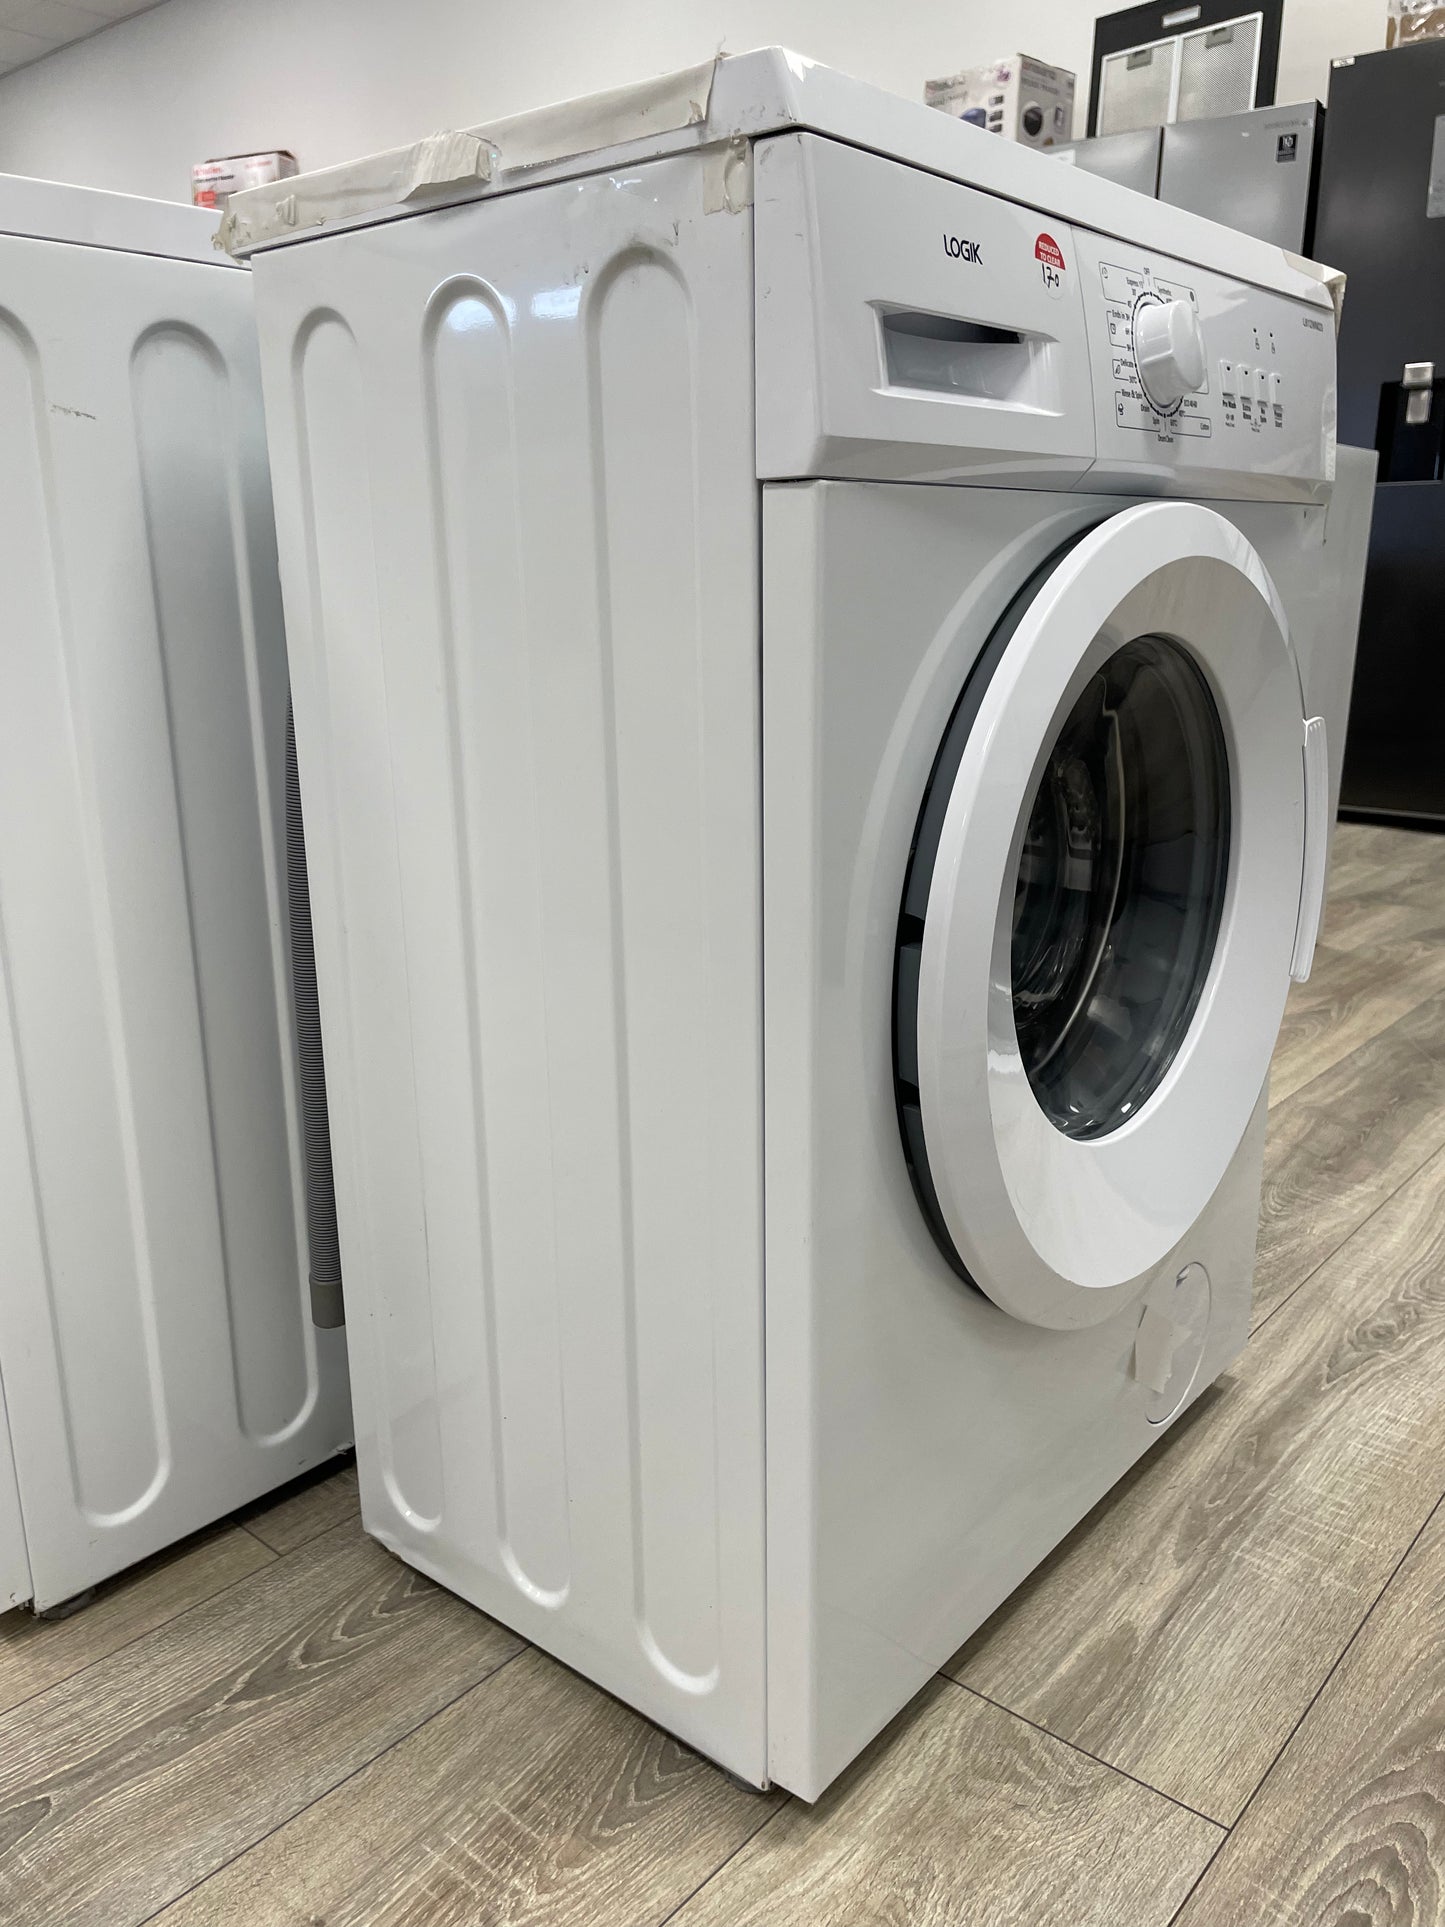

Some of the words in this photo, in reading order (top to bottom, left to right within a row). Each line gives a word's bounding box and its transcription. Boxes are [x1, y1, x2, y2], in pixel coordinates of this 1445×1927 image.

[943, 233, 983, 265] LOGIK
[1040, 251, 1047, 262] TO
[1047, 254, 1061, 267] CLEAR
